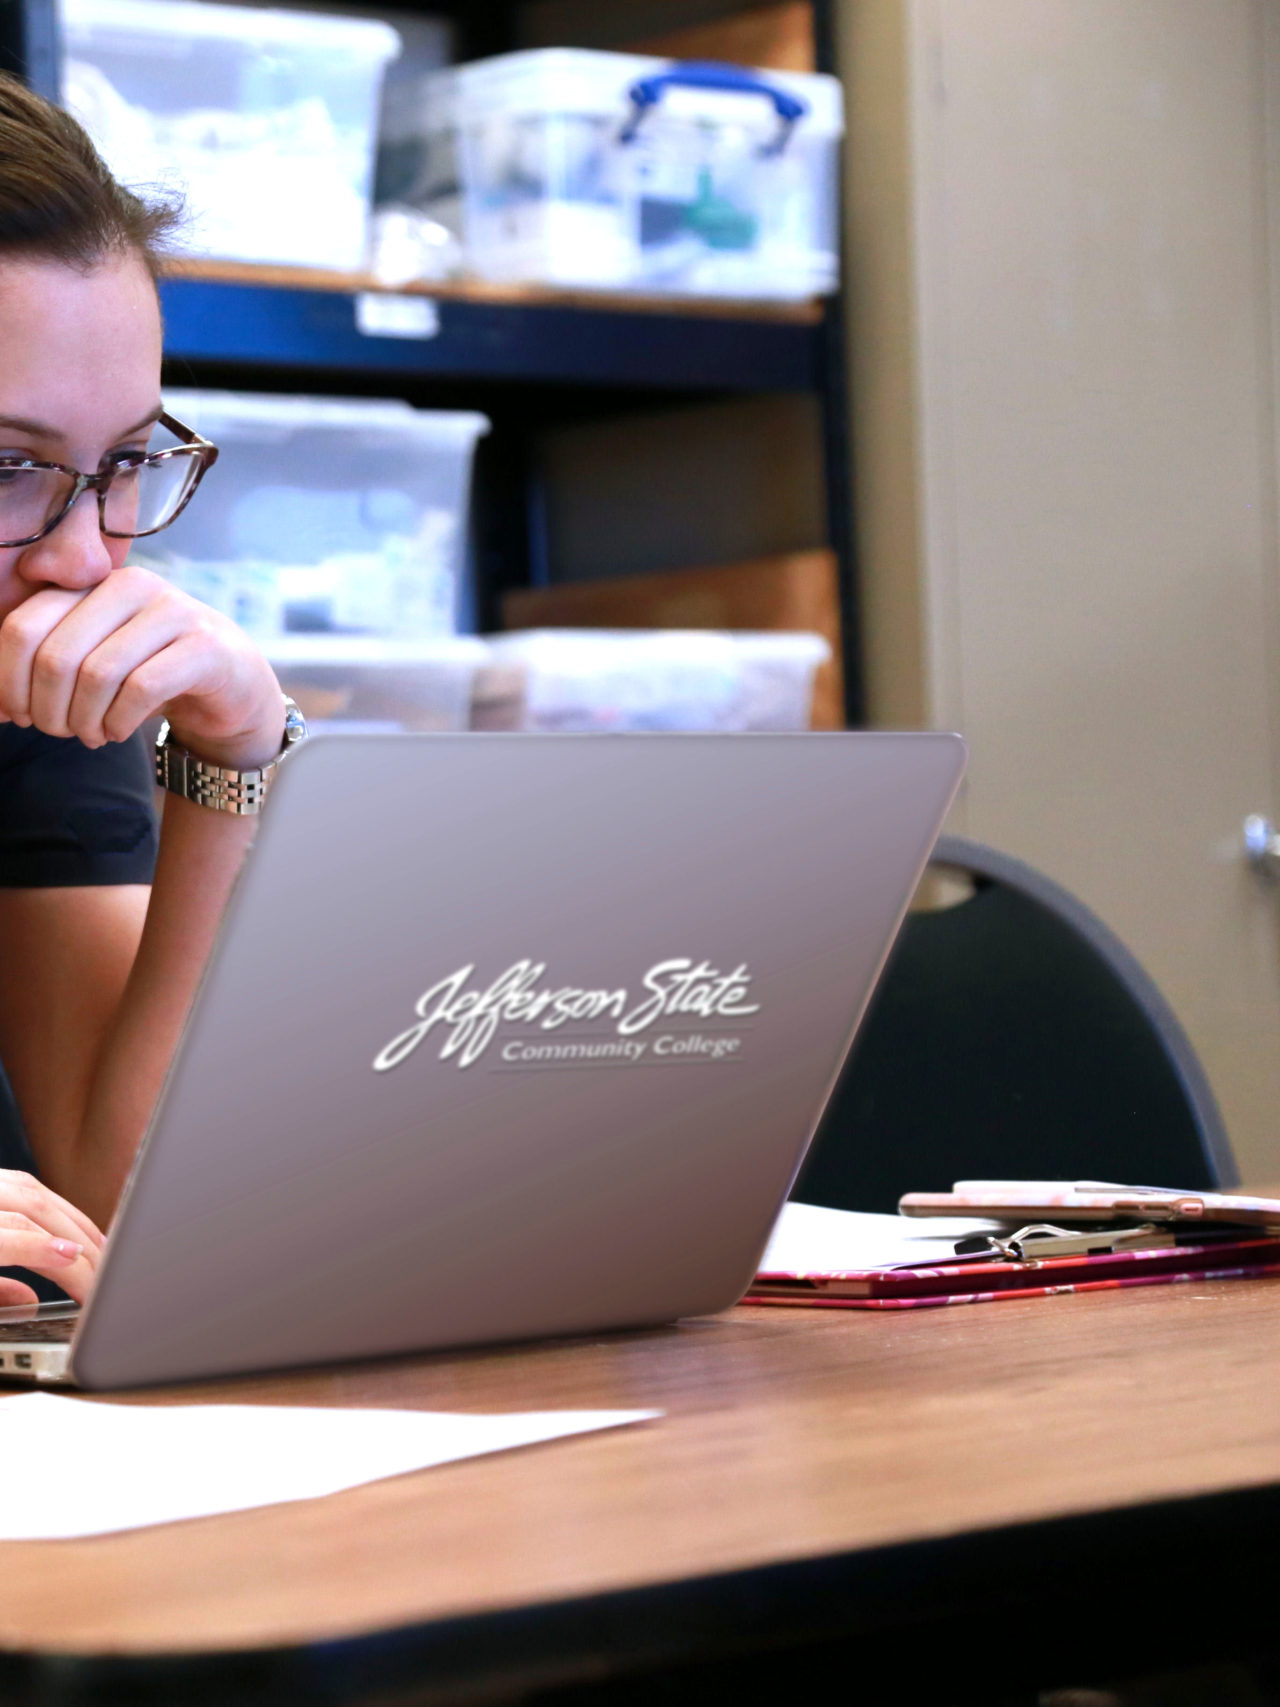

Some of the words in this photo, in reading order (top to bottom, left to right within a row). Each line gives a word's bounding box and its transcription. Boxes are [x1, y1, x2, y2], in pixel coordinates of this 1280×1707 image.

[373, 958, 628, 1072] Jefferson
[617, 957, 762, 1035] State
[501, 1038, 647, 1062] Community
[652, 1033, 742, 1058] College
